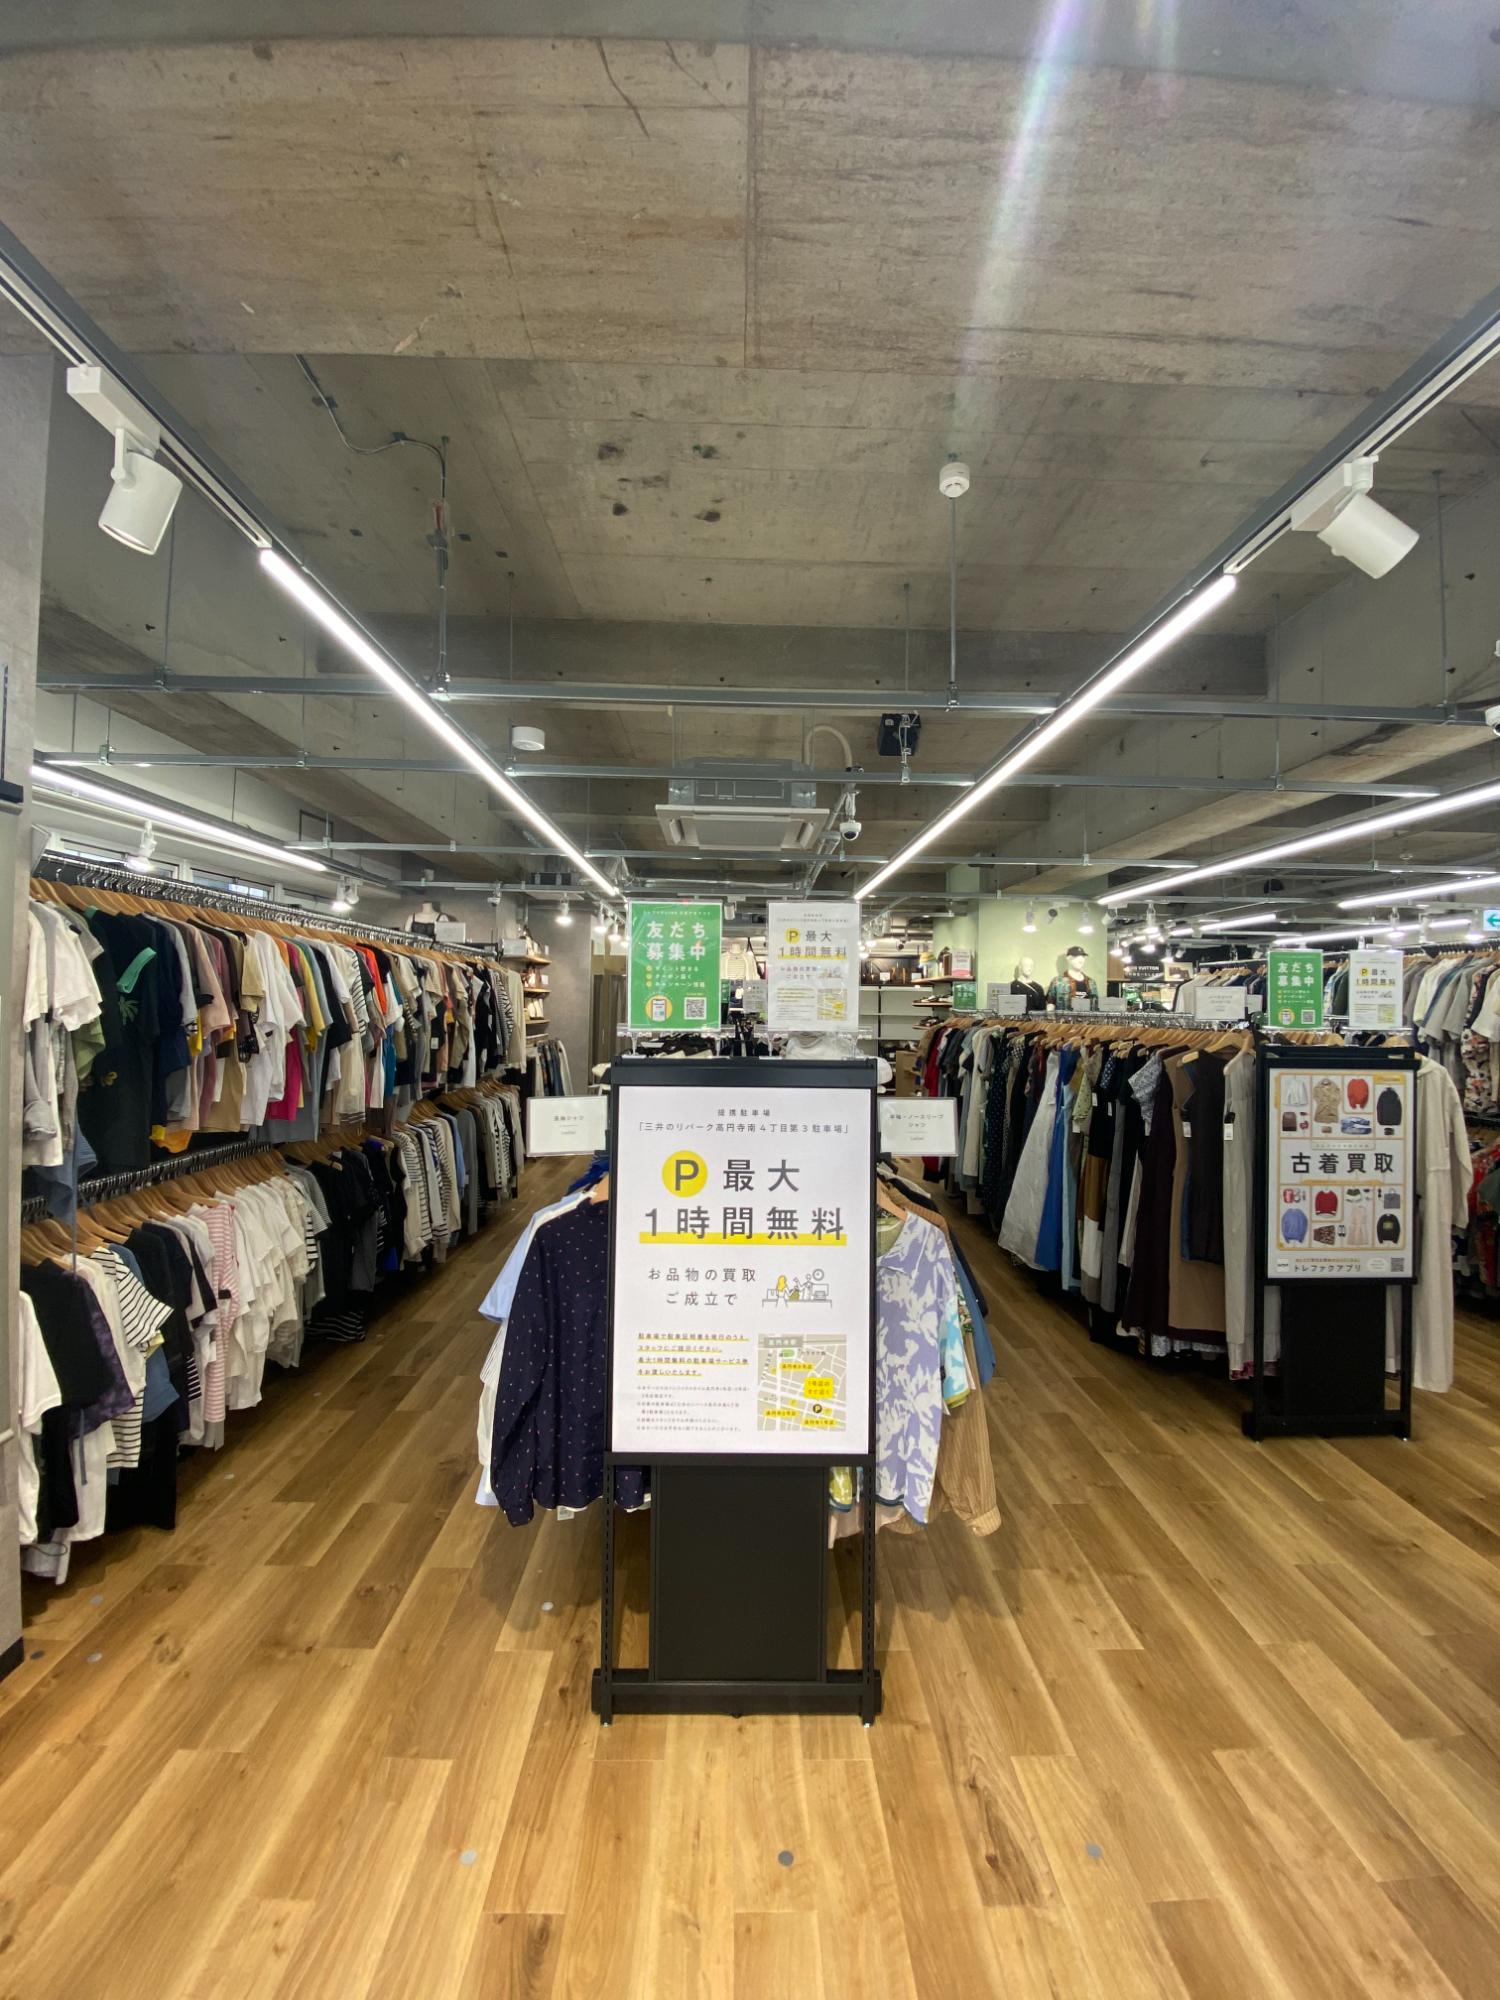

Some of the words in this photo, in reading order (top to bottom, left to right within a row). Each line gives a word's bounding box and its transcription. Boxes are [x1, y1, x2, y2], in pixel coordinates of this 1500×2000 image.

[646, 920, 706, 939] 友だち
[805, 930, 832, 942] 最大
[646, 941, 706, 961] 募集中
[779, 946, 847, 958] 1時間無料
[1278, 961, 1315, 974] 友だち
[1278, 975, 1315, 988] 募集中
[717, 1108, 771, 1117] 提携駐車場
[1290, 1151, 1394, 1174] 古着買取
[674, 1159, 700, 1191] P
[723, 1158, 800, 1193] 最大
[644, 1205, 845, 1241] 1時間無料
[648, 1267, 757, 1283] お品物の買取
[1293, 1264, 1361, 1272] トレファクアプリ
[665, 1291, 739, 1306] ご成立で
